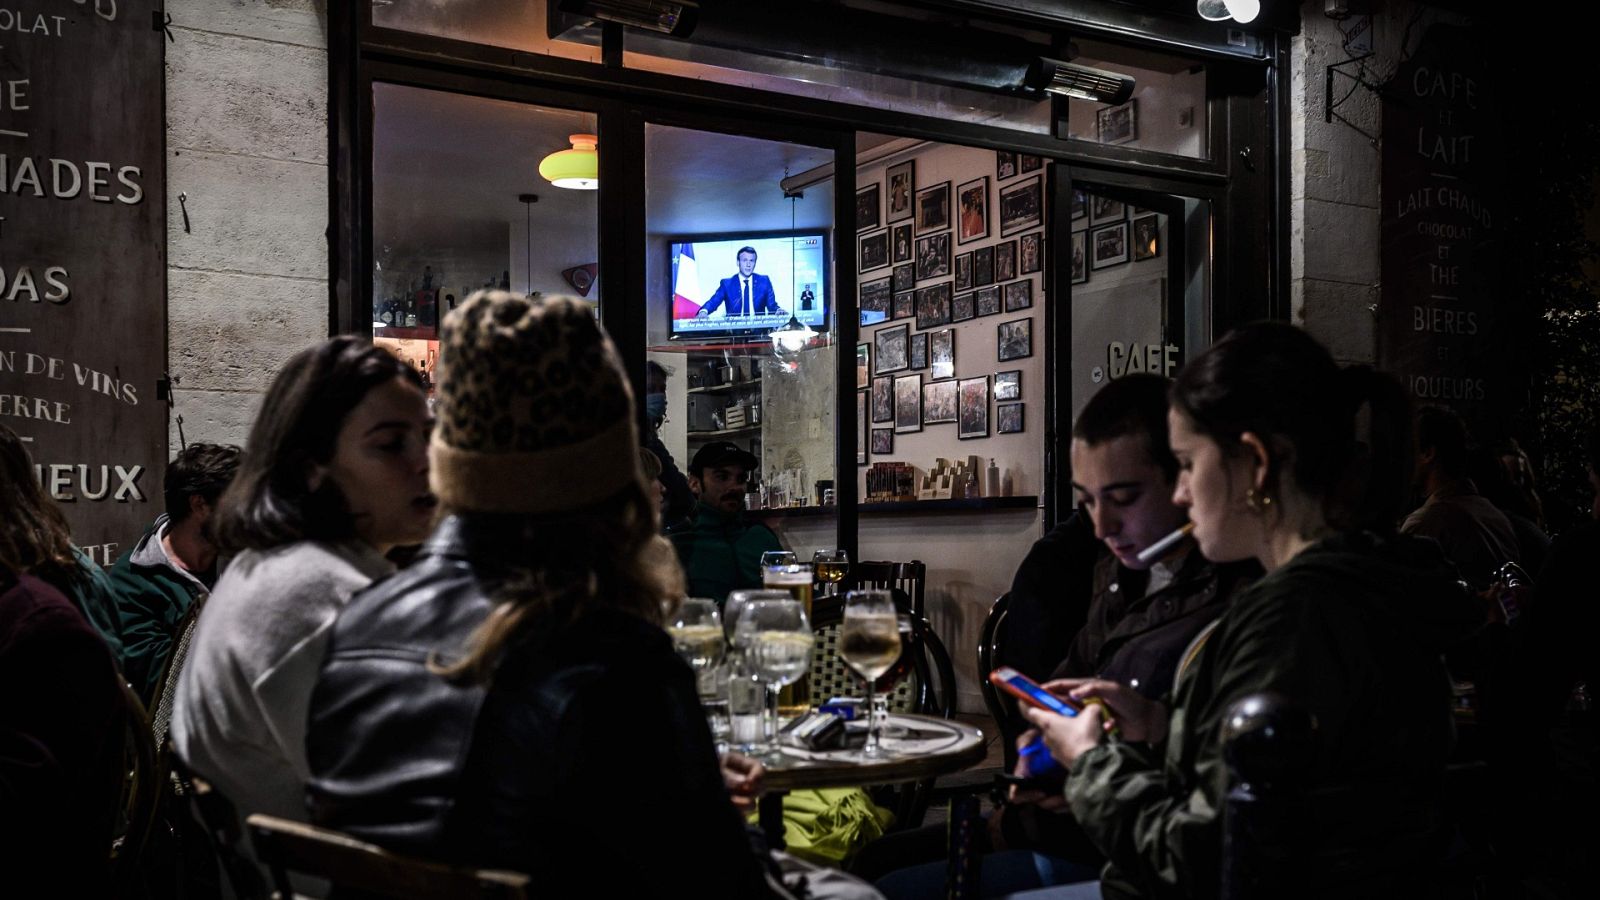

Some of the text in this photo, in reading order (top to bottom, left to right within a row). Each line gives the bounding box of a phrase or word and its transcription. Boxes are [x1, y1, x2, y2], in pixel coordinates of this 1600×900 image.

[0, 79, 30, 110] E
[1417, 126, 1475, 165] LAIT
[0, 153, 144, 205] ADES
[1397, 187, 1433, 219] LAIT
[1417, 221, 1472, 240] CHOCOLAT
[1428, 263, 1459, 286] THE
[1413, 305, 1479, 336] BIERES
[24, 352, 65, 381] DE
[72, 362, 139, 406] VINS
[0, 394, 71, 425] ERRE
[34, 463, 145, 501] EUX
